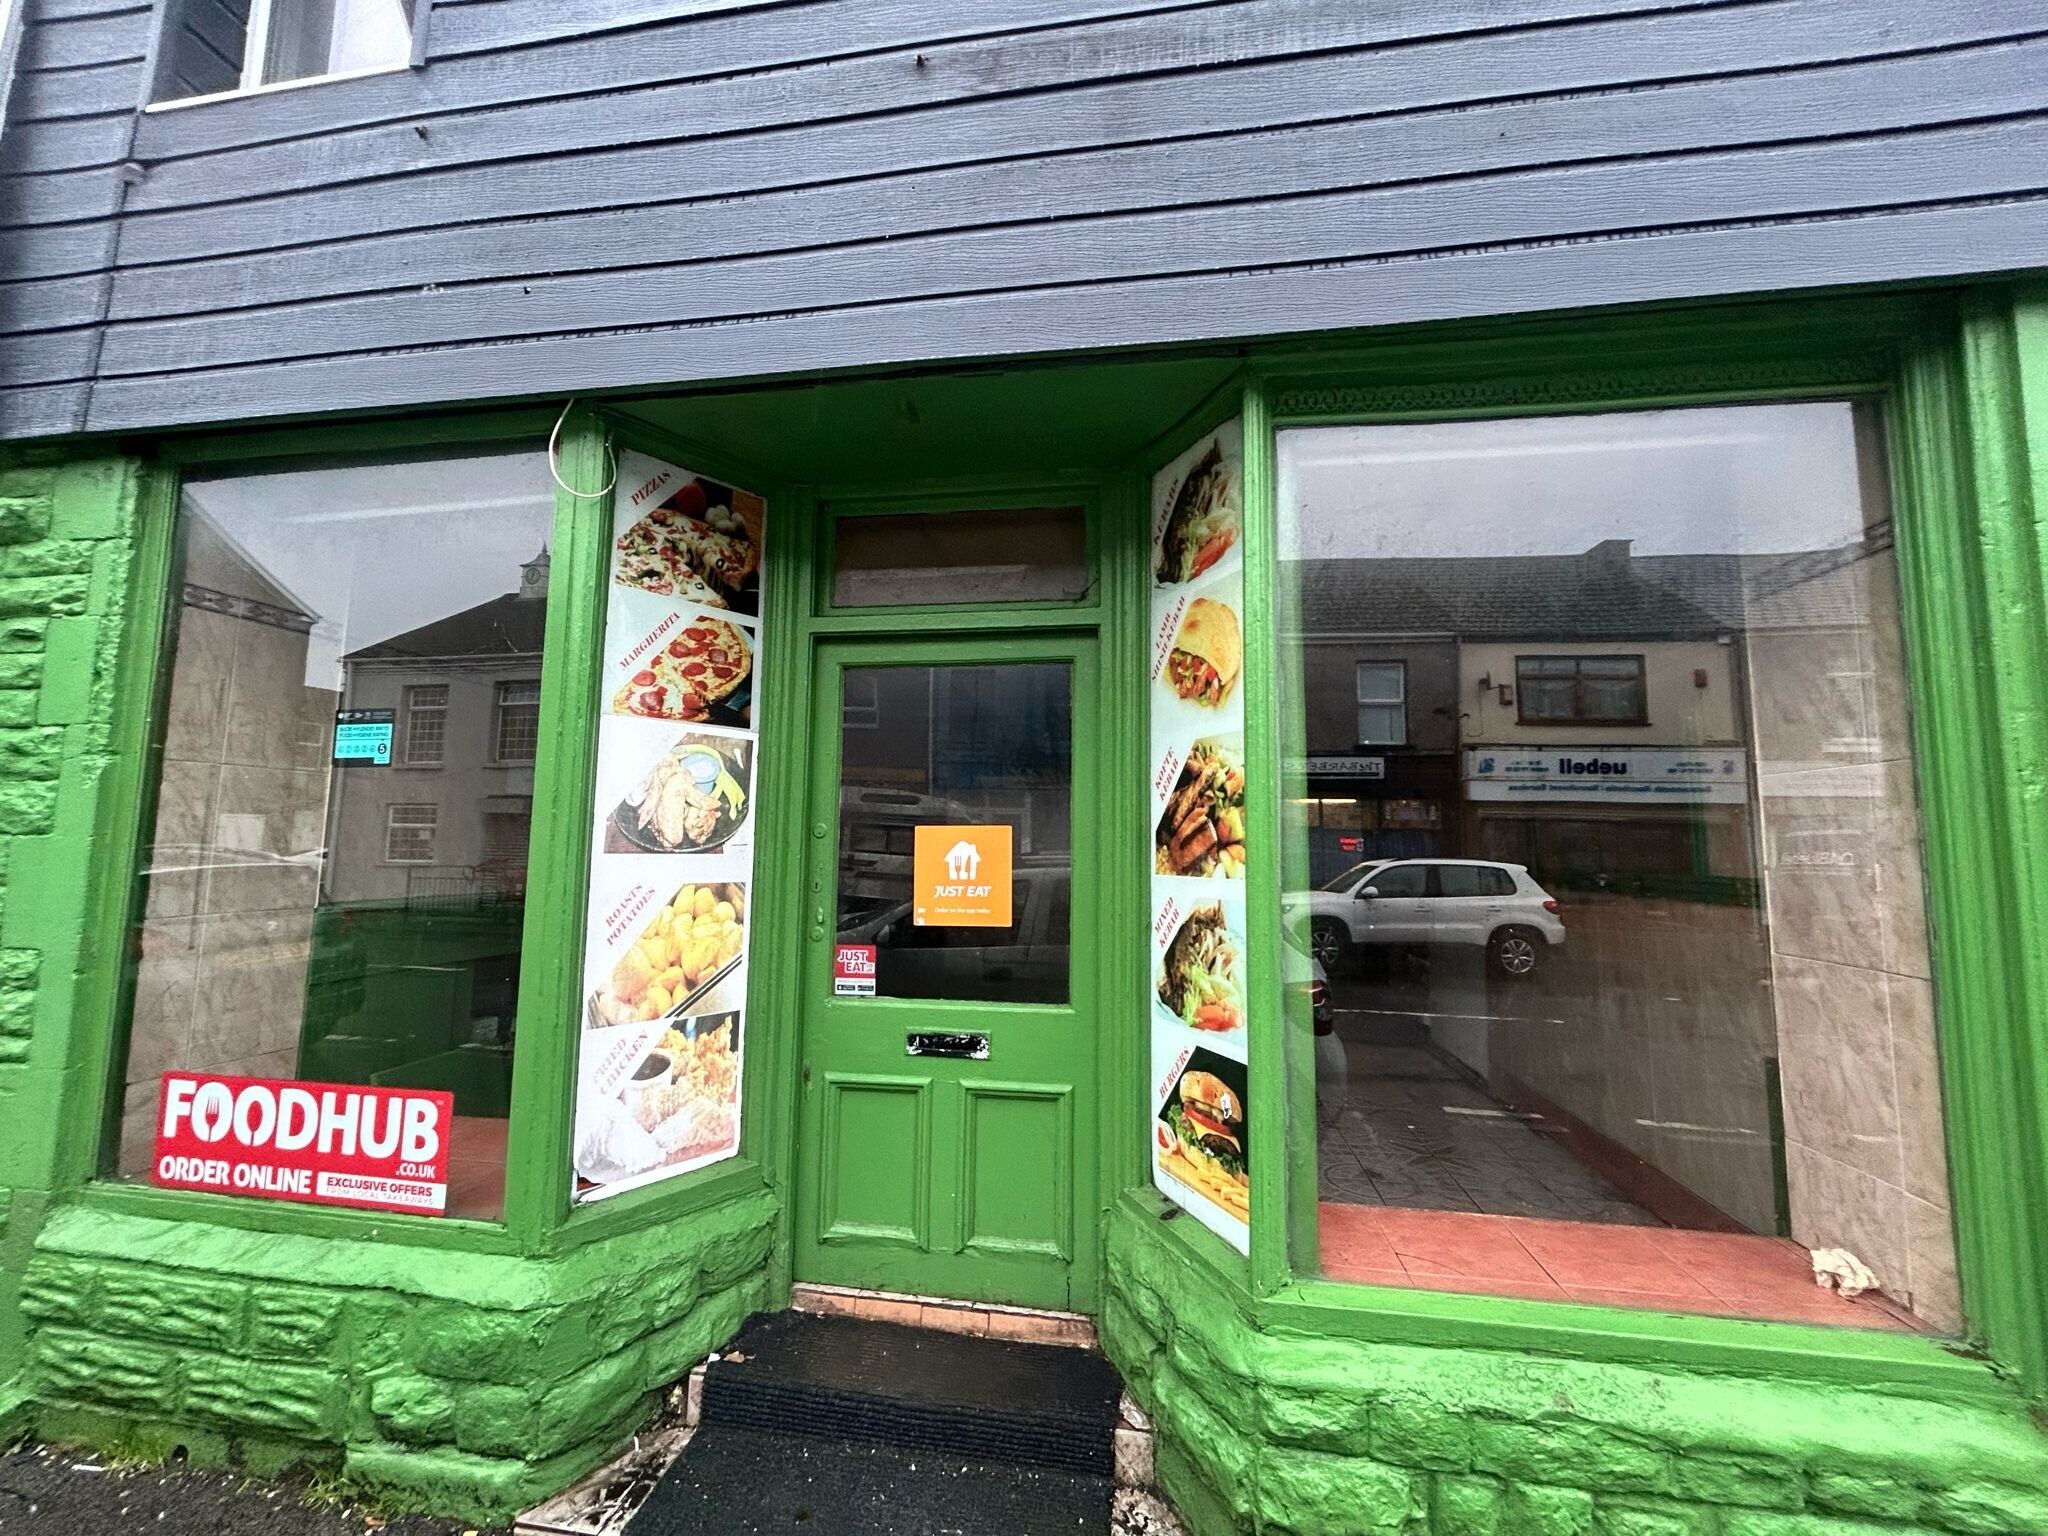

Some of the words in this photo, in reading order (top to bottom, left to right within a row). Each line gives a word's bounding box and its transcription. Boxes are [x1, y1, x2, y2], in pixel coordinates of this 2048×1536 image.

[631, 470, 671, 506] PIZZAS
[1153, 477, 1179, 546] KEBABS
[1155, 612, 1171, 649] LAMB
[1166, 596, 1185, 641] KEBAB
[619, 612, 680, 669] MARGHERITA
[379, 744, 386, 752] 5
[1155, 746, 1173, 789] KOFTE
[1160, 758, 1179, 801] KEBAB
[605, 882, 642, 927] ROASTS
[934, 885, 965, 898] JUST
[966, 885, 992, 897] EAT
[607, 888, 655, 947] POTATOES
[1155, 897, 1173, 933] MIXED
[1160, 908, 1179, 948] KEBAB
[839, 951, 867, 961] JUST
[846, 962, 866, 972] EAT
[600, 1031, 648, 1095] CHICKEN
[1159, 1048, 1190, 1099] BURGERS
[163, 1078, 439, 1163] FOODHUB
[160, 1154, 229, 1184] ORDER
[233, 1162, 312, 1194] ONLINE
[327, 1176, 388, 1192] EXCLUSIVE
[389, 1183, 433, 1198] OFFERS
[395, 1162, 436, 1179] .CO.UK
[353, 1189, 380, 1200] LOCAL
[383, 1192, 434, 1206] TAKEAWAYS
